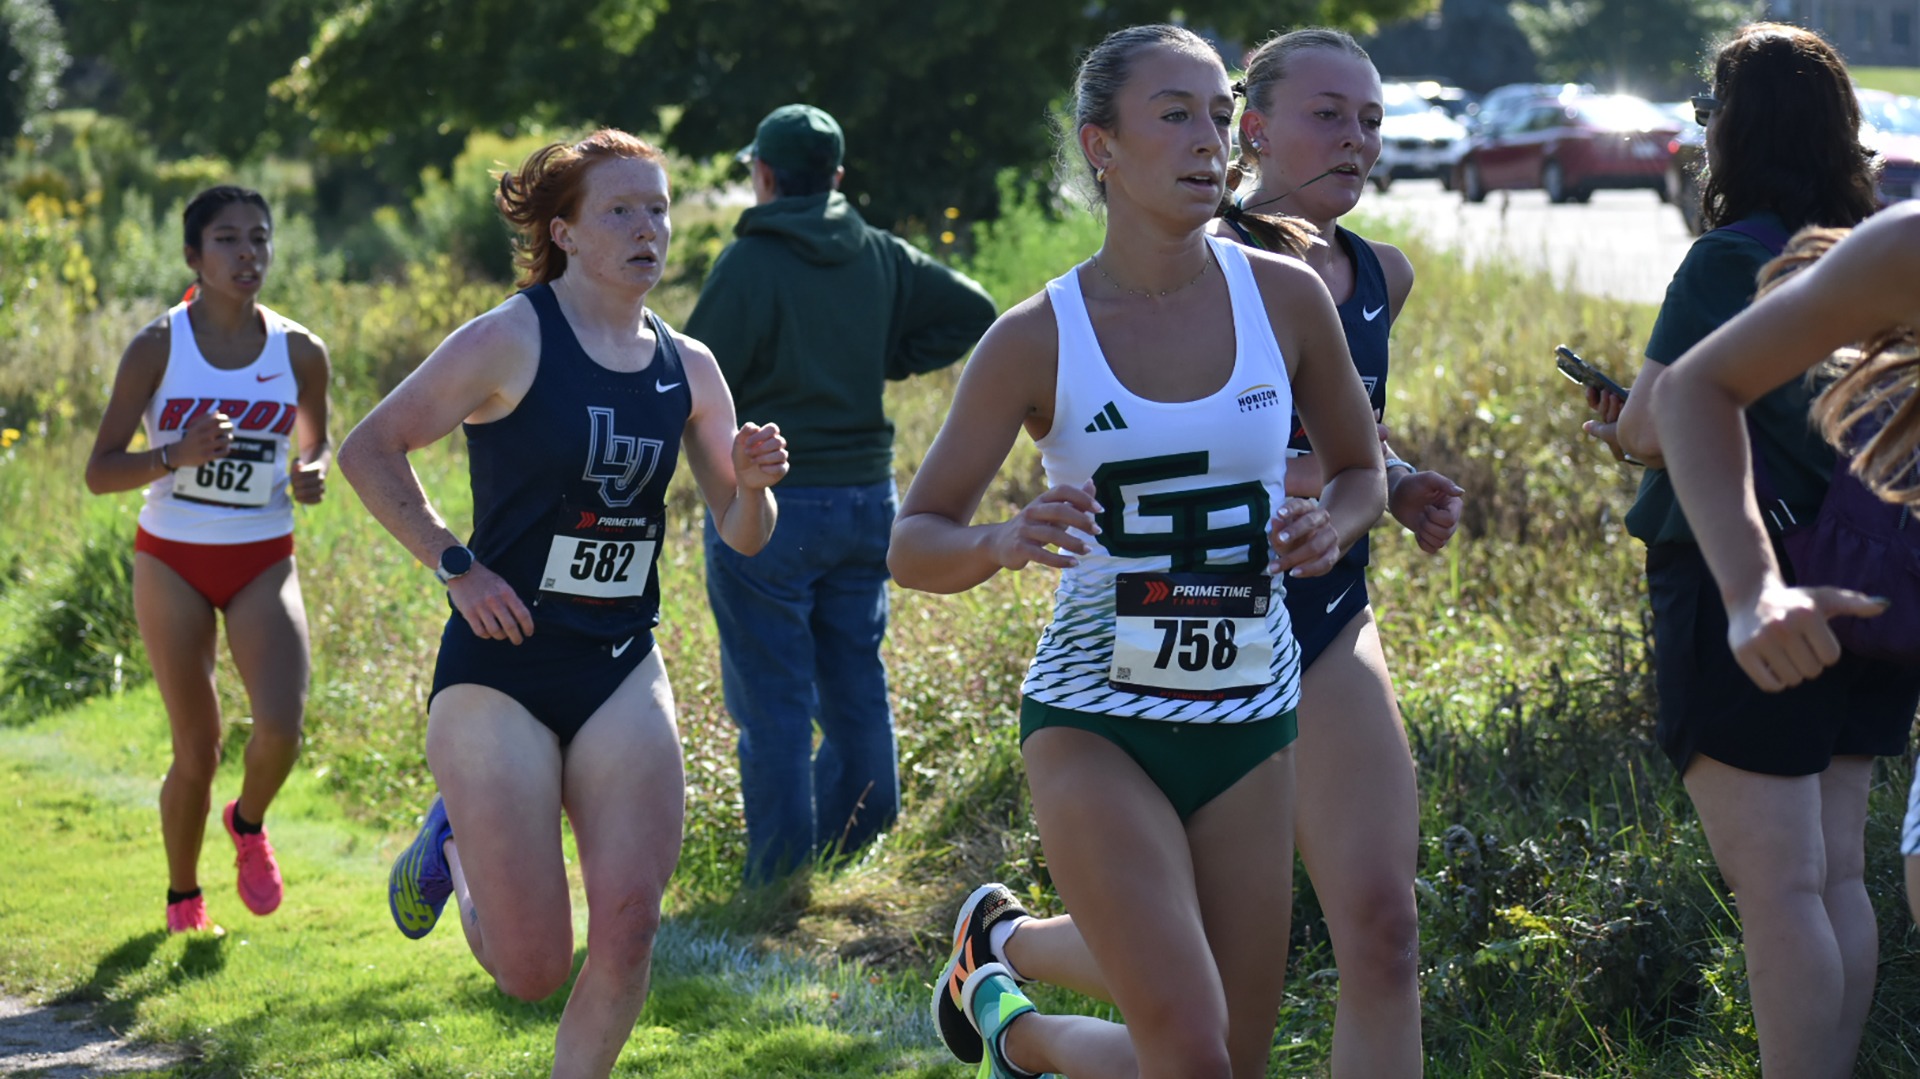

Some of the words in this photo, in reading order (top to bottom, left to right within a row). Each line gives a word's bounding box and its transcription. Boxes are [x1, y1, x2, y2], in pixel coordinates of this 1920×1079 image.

[1238, 390, 1277, 407] HORIZON
[196, 460, 253, 493] 662
[597, 516, 647, 527] PRIMETIME
[570, 541, 635, 583] 582
[1172, 585, 1253, 598] PRIMETIME
[1173, 598, 1219, 606] TIMING
[1153, 618, 1239, 672] 758
